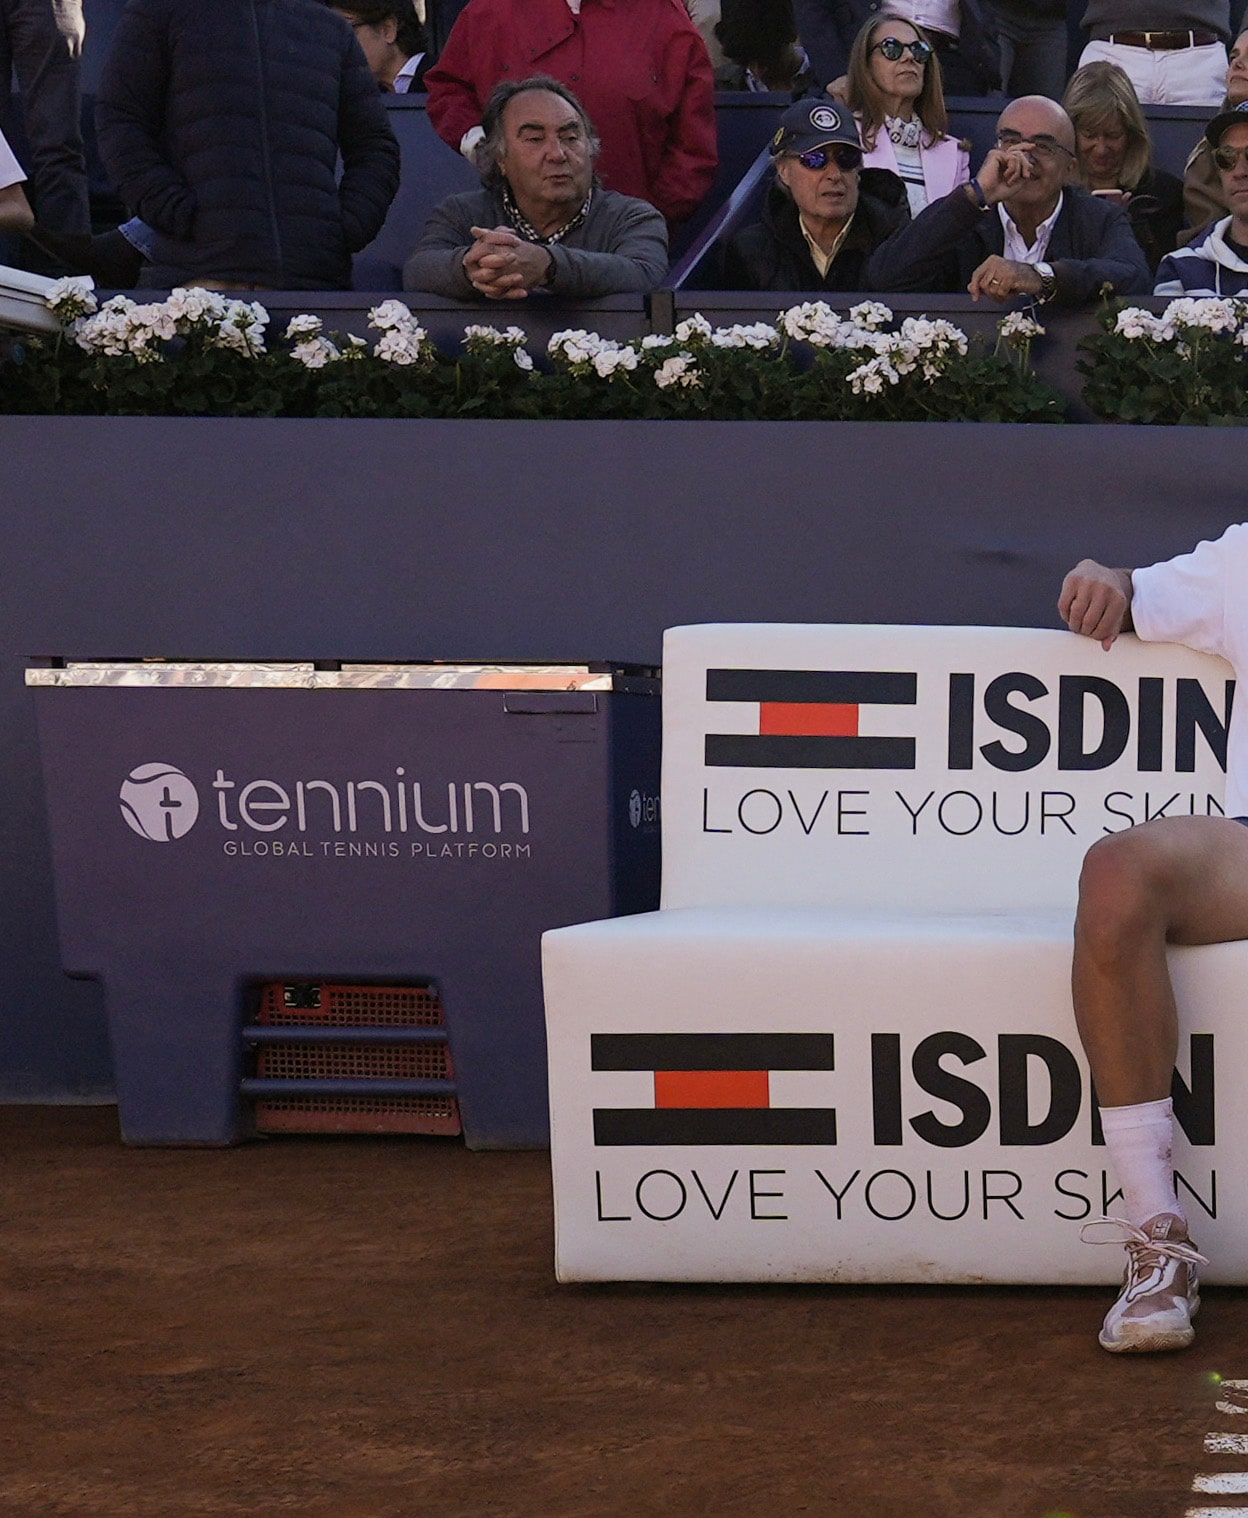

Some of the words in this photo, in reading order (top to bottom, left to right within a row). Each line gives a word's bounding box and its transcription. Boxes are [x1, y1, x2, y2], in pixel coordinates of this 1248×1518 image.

[948, 671, 1236, 775] ISDIN
[212, 765, 530, 835] tennium
[702, 787, 870, 836] LOVE
[895, 789, 1077, 837] YOUR
[223, 841, 313, 857] GLOBAL
[320, 841, 400, 858] TENNIS
[410, 842, 531, 859] PLATFORM
[595, 1169, 788, 1222] LOVE
[814, 1169, 1025, 1222] YOUR
[1054, 1169, 1217, 1221] SKN
